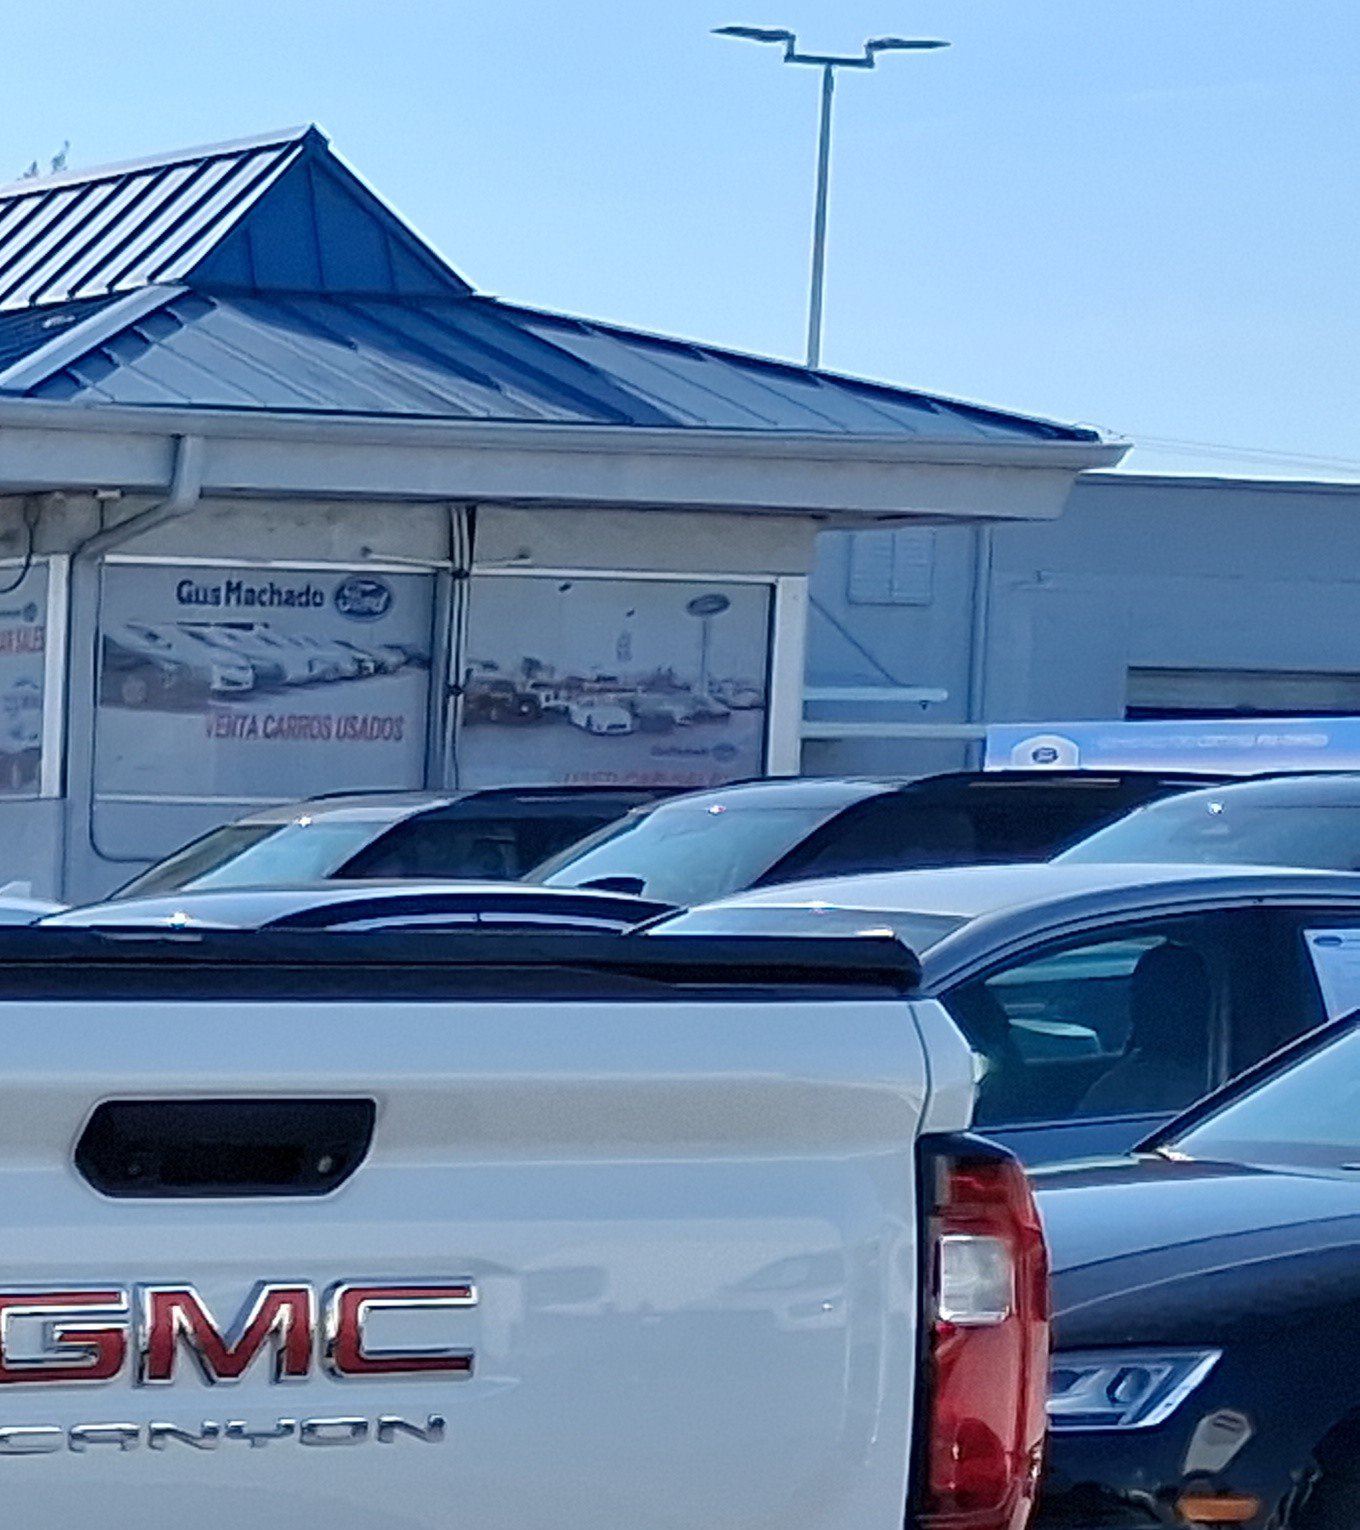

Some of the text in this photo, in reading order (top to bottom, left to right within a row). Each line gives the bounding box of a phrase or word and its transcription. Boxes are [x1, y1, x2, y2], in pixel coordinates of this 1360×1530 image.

[206, 713, 404, 743] VENTA CARROS USADOS
